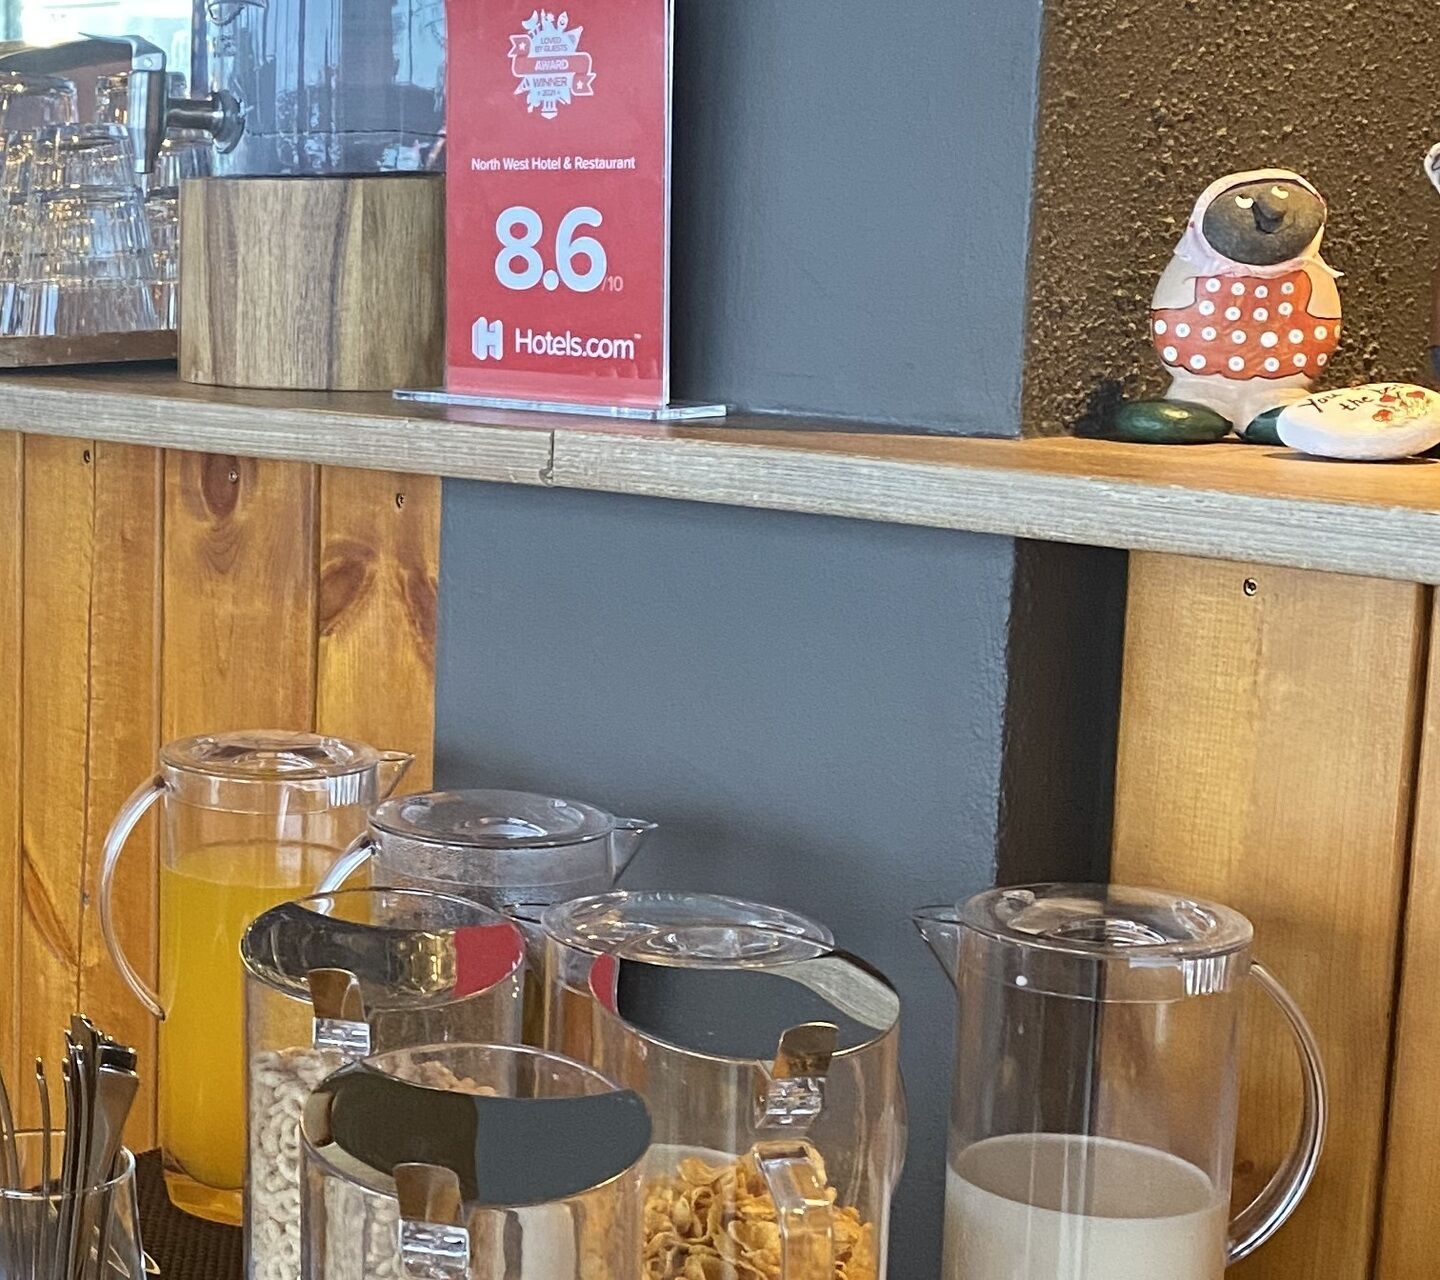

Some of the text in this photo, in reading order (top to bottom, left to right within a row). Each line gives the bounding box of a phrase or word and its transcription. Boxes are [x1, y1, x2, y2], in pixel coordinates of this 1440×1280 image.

[540, 36, 562, 45] LOVED
[544, 43, 568, 52] GUESTS
[534, 59, 569, 71] AWARD
[532, 76, 568, 87] WINNER
[471, 156, 636, 171] North West Hotel & Restaurant
[494, 205, 607, 293] 8.6
[1298, 392, 1344, 413] You
[1339, 396, 1375, 411] the
